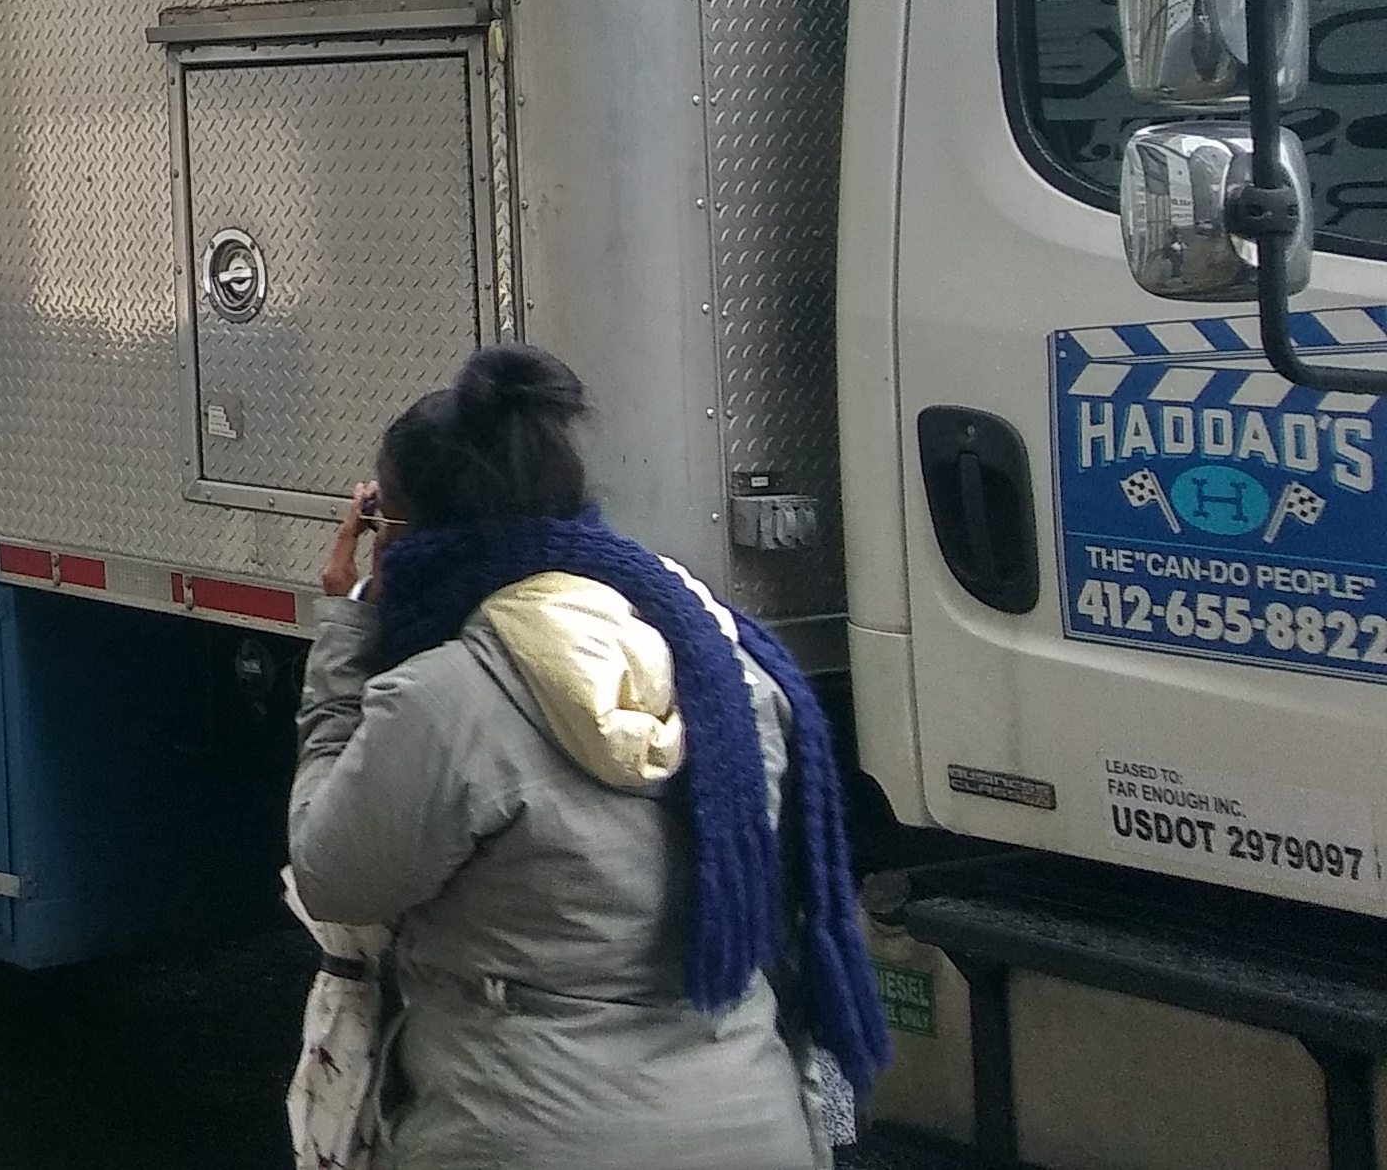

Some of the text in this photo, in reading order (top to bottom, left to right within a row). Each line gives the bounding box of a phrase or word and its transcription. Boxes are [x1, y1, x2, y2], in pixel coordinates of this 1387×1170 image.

[1078, 401, 1374, 494] HADDAD'S
[1085, 545, 1135, 573] THE
[1256, 565, 1376, 601] PEOPLE"
[1077, 578, 1387, 665] 412-655-8822
[1105, 759, 1183, 785] LEASED TO:
[1108, 778, 1247, 819] FAR ENOUGH INC.
[1111, 804, 1363, 880] USDOT 2979097
[879, 970, 930, 1007] IESEL
